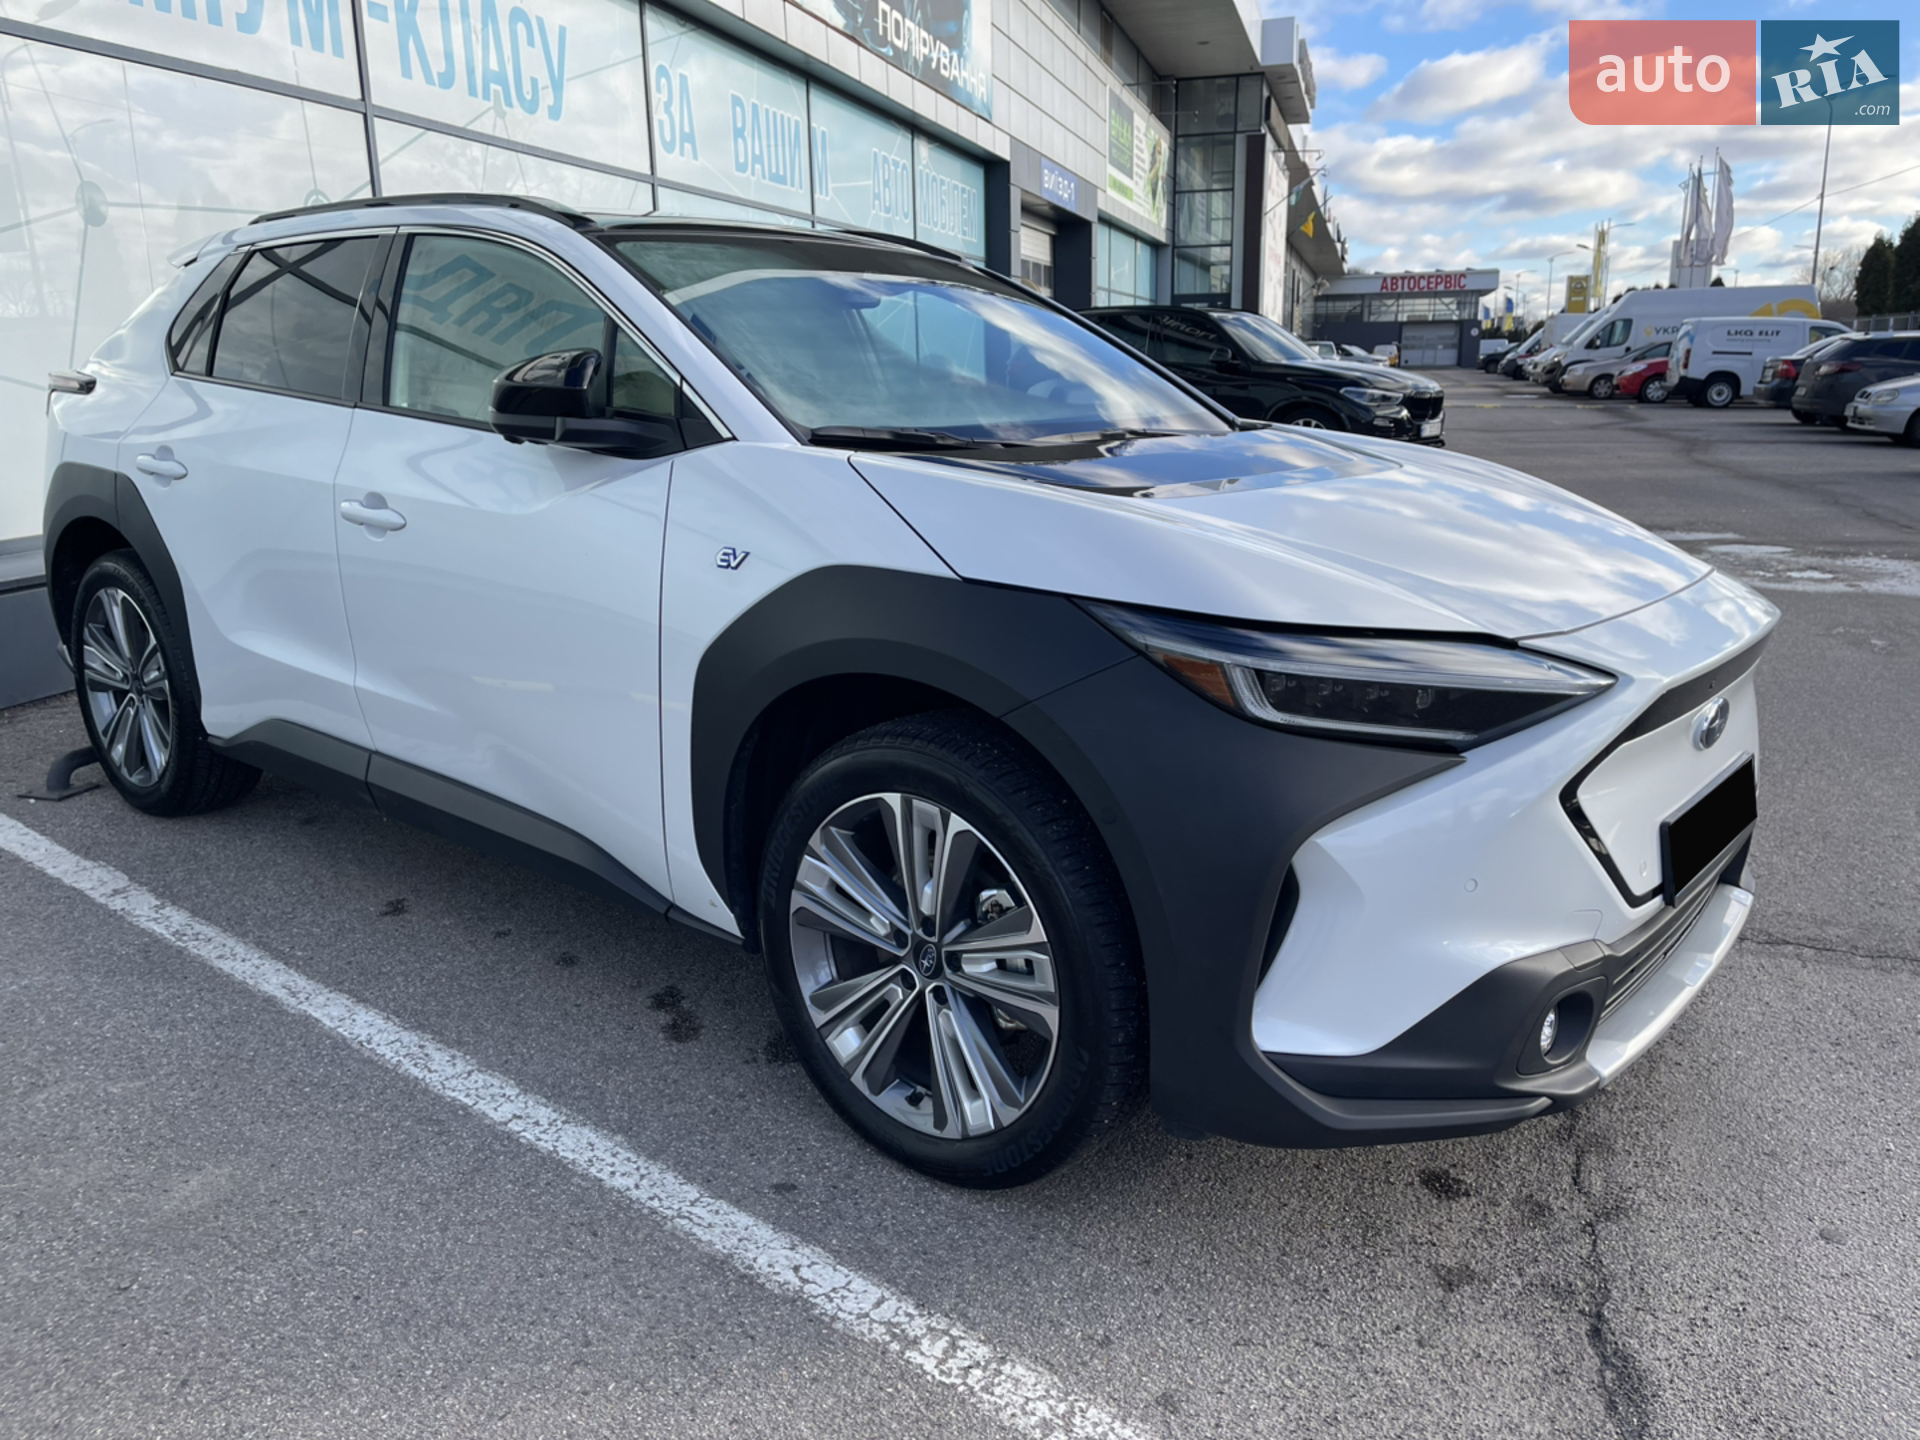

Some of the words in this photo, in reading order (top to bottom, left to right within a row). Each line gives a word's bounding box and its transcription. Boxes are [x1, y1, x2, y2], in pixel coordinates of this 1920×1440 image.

[877, 0, 987, 103] ПОЛІРУВАННЯ
[655, 62, 699, 163] ЗА
[1380, 273, 1467, 292] АВТОСЕРВІС
[714, 546, 751, 571] EV
